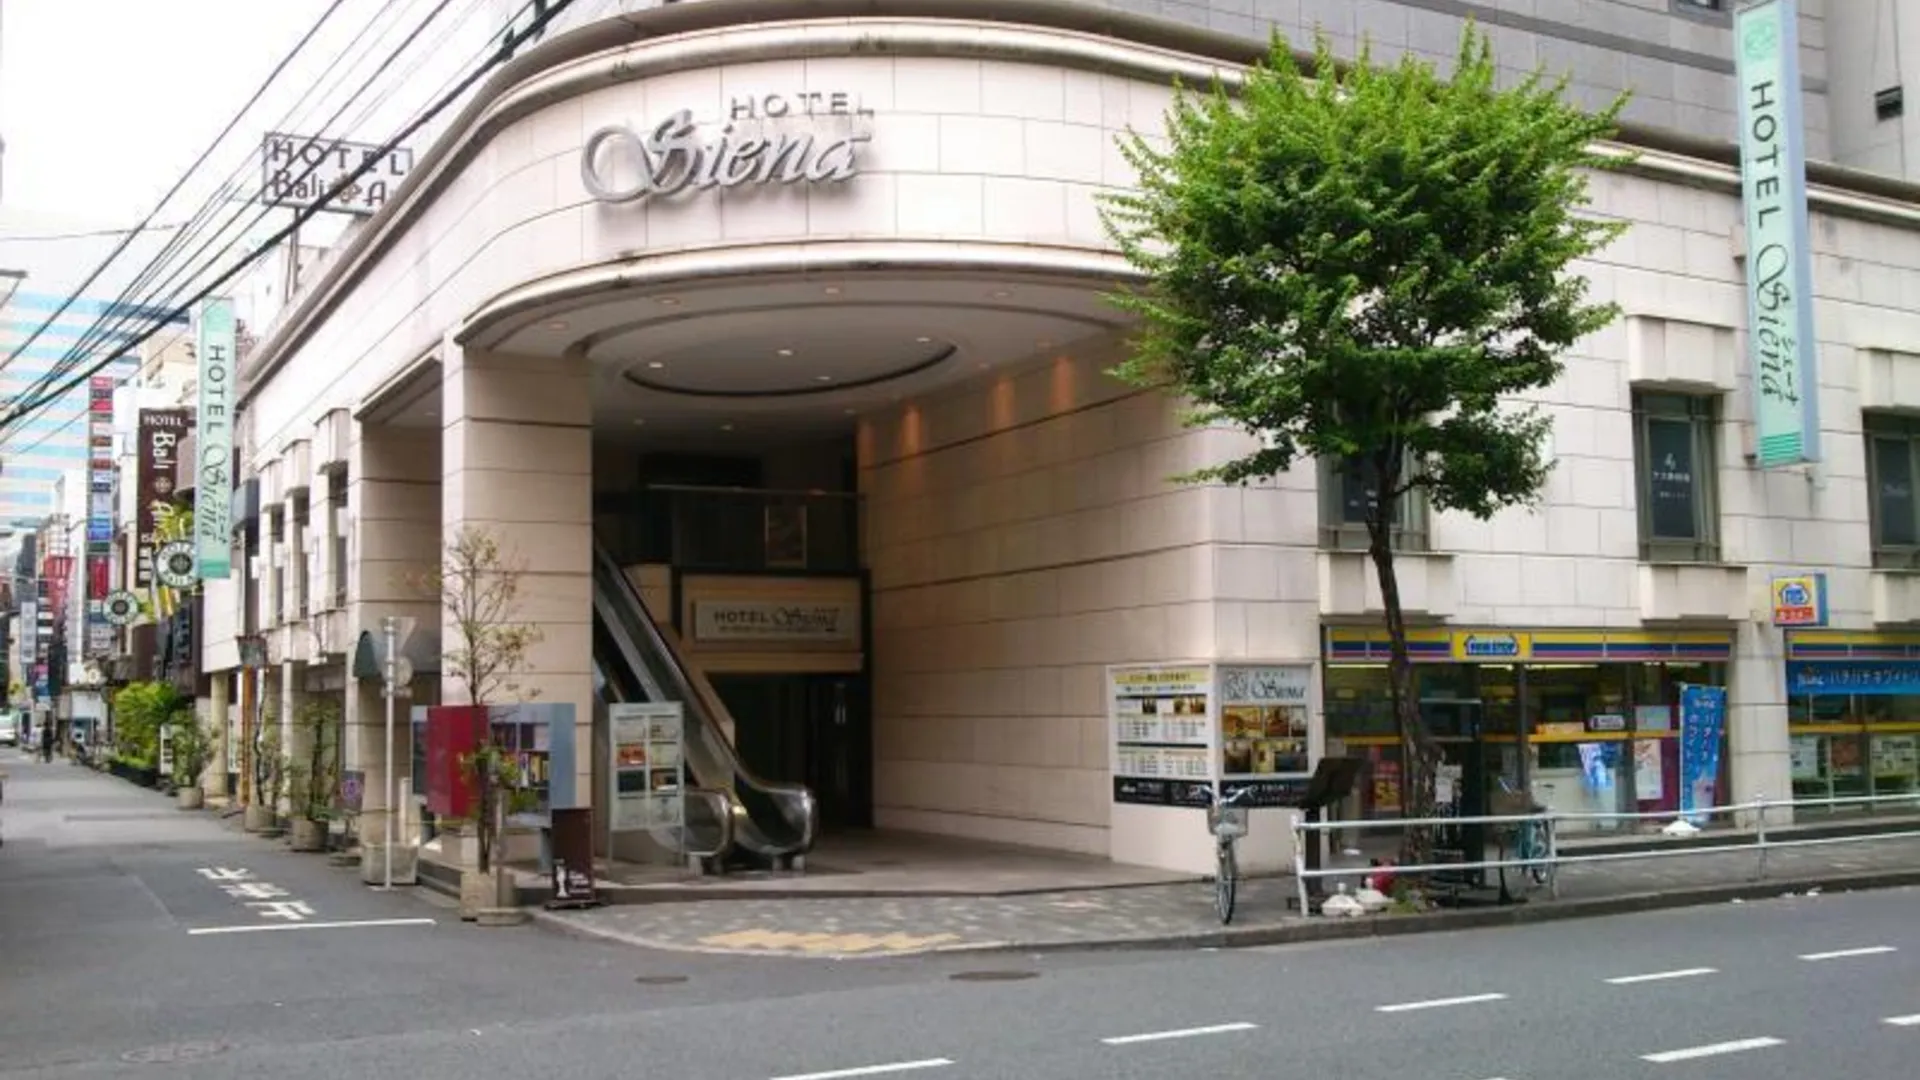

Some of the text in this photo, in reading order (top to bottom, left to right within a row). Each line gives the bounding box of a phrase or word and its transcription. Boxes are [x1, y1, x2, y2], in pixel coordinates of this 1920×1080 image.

[731, 92, 875, 120] HOTEL
[272, 138, 404, 176] HOTEL
[580, 108, 872, 203] Siena
[274, 170, 325, 200] Bali
[1751, 80, 1791, 403] HOTEL Siena
[207, 345, 226, 434] HOTEL
[144, 414, 184, 427] HOTEL
[153, 430, 176, 469] Bali
[714, 610, 769, 624] HOTEL
